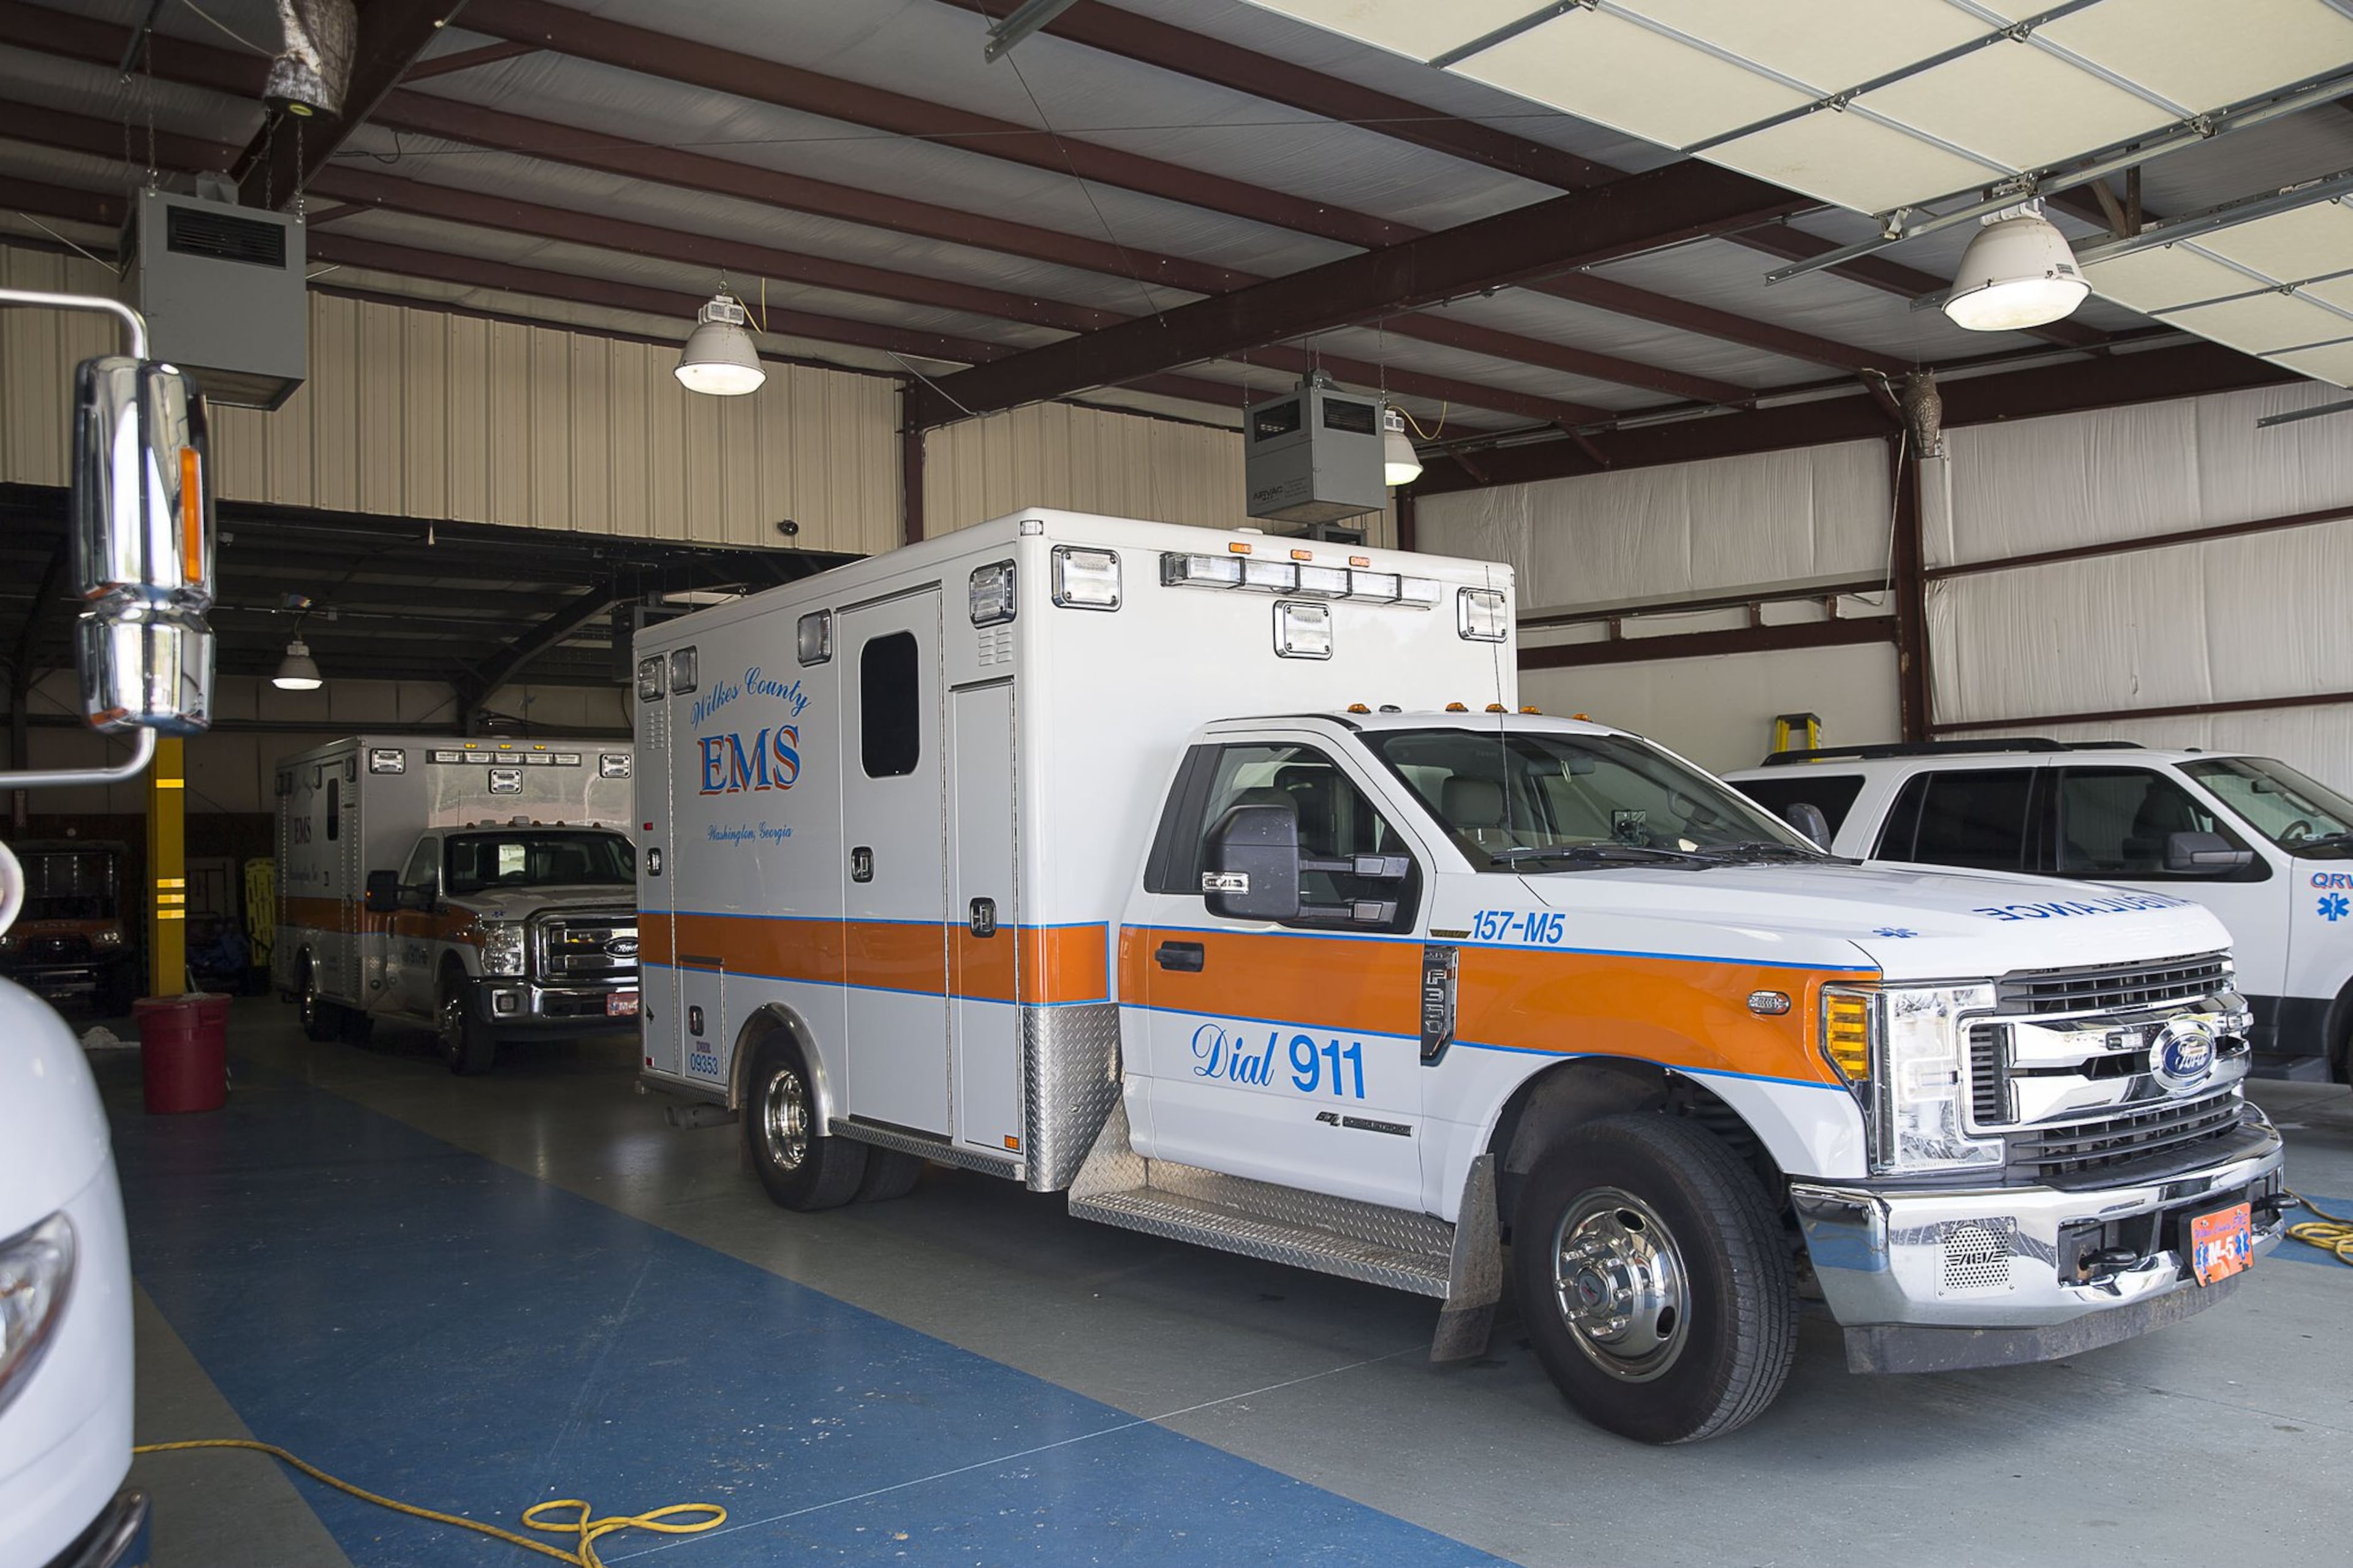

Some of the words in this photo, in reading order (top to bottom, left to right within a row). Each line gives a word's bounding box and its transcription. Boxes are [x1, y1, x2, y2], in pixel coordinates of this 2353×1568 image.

[690, 680, 741, 730] Wilkes
[744, 667, 812, 717] County
[697, 724, 800, 795] EMS
[708, 825, 756, 847] Washington,
[759, 821, 793, 846] Georgia
[1472, 910, 1566, 944] 157-M5
[691, 1053, 718, 1075] 09353
[1192, 1023, 1278, 1086] Dial
[1289, 1035, 1365, 1099] 911
[2208, 1235, 2235, 1266] M-5
